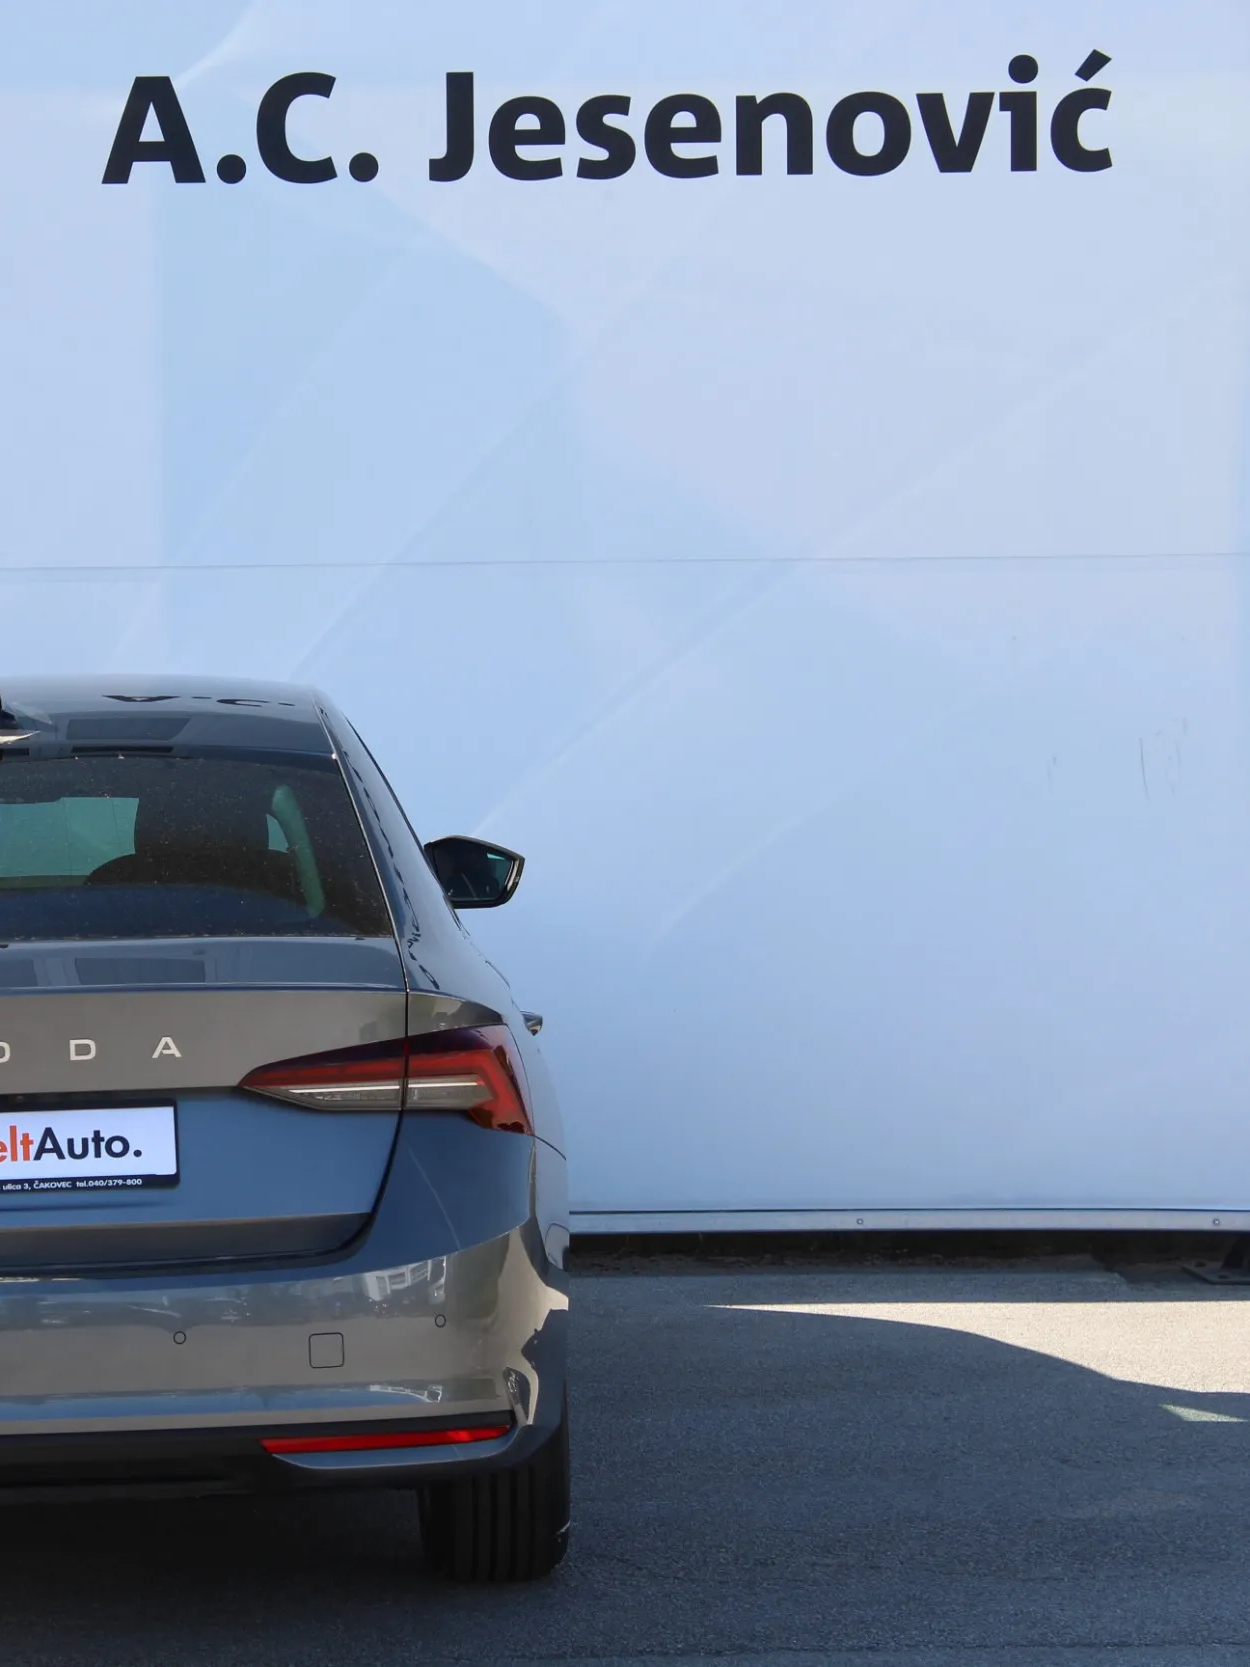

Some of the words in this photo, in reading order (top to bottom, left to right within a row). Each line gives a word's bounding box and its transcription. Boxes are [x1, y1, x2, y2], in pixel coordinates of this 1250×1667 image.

[101, 71, 379, 185] A.C.
[428, 48, 1113, 182] Jesenović
[33, 1180, 72, 1189] ČAKOVEC
